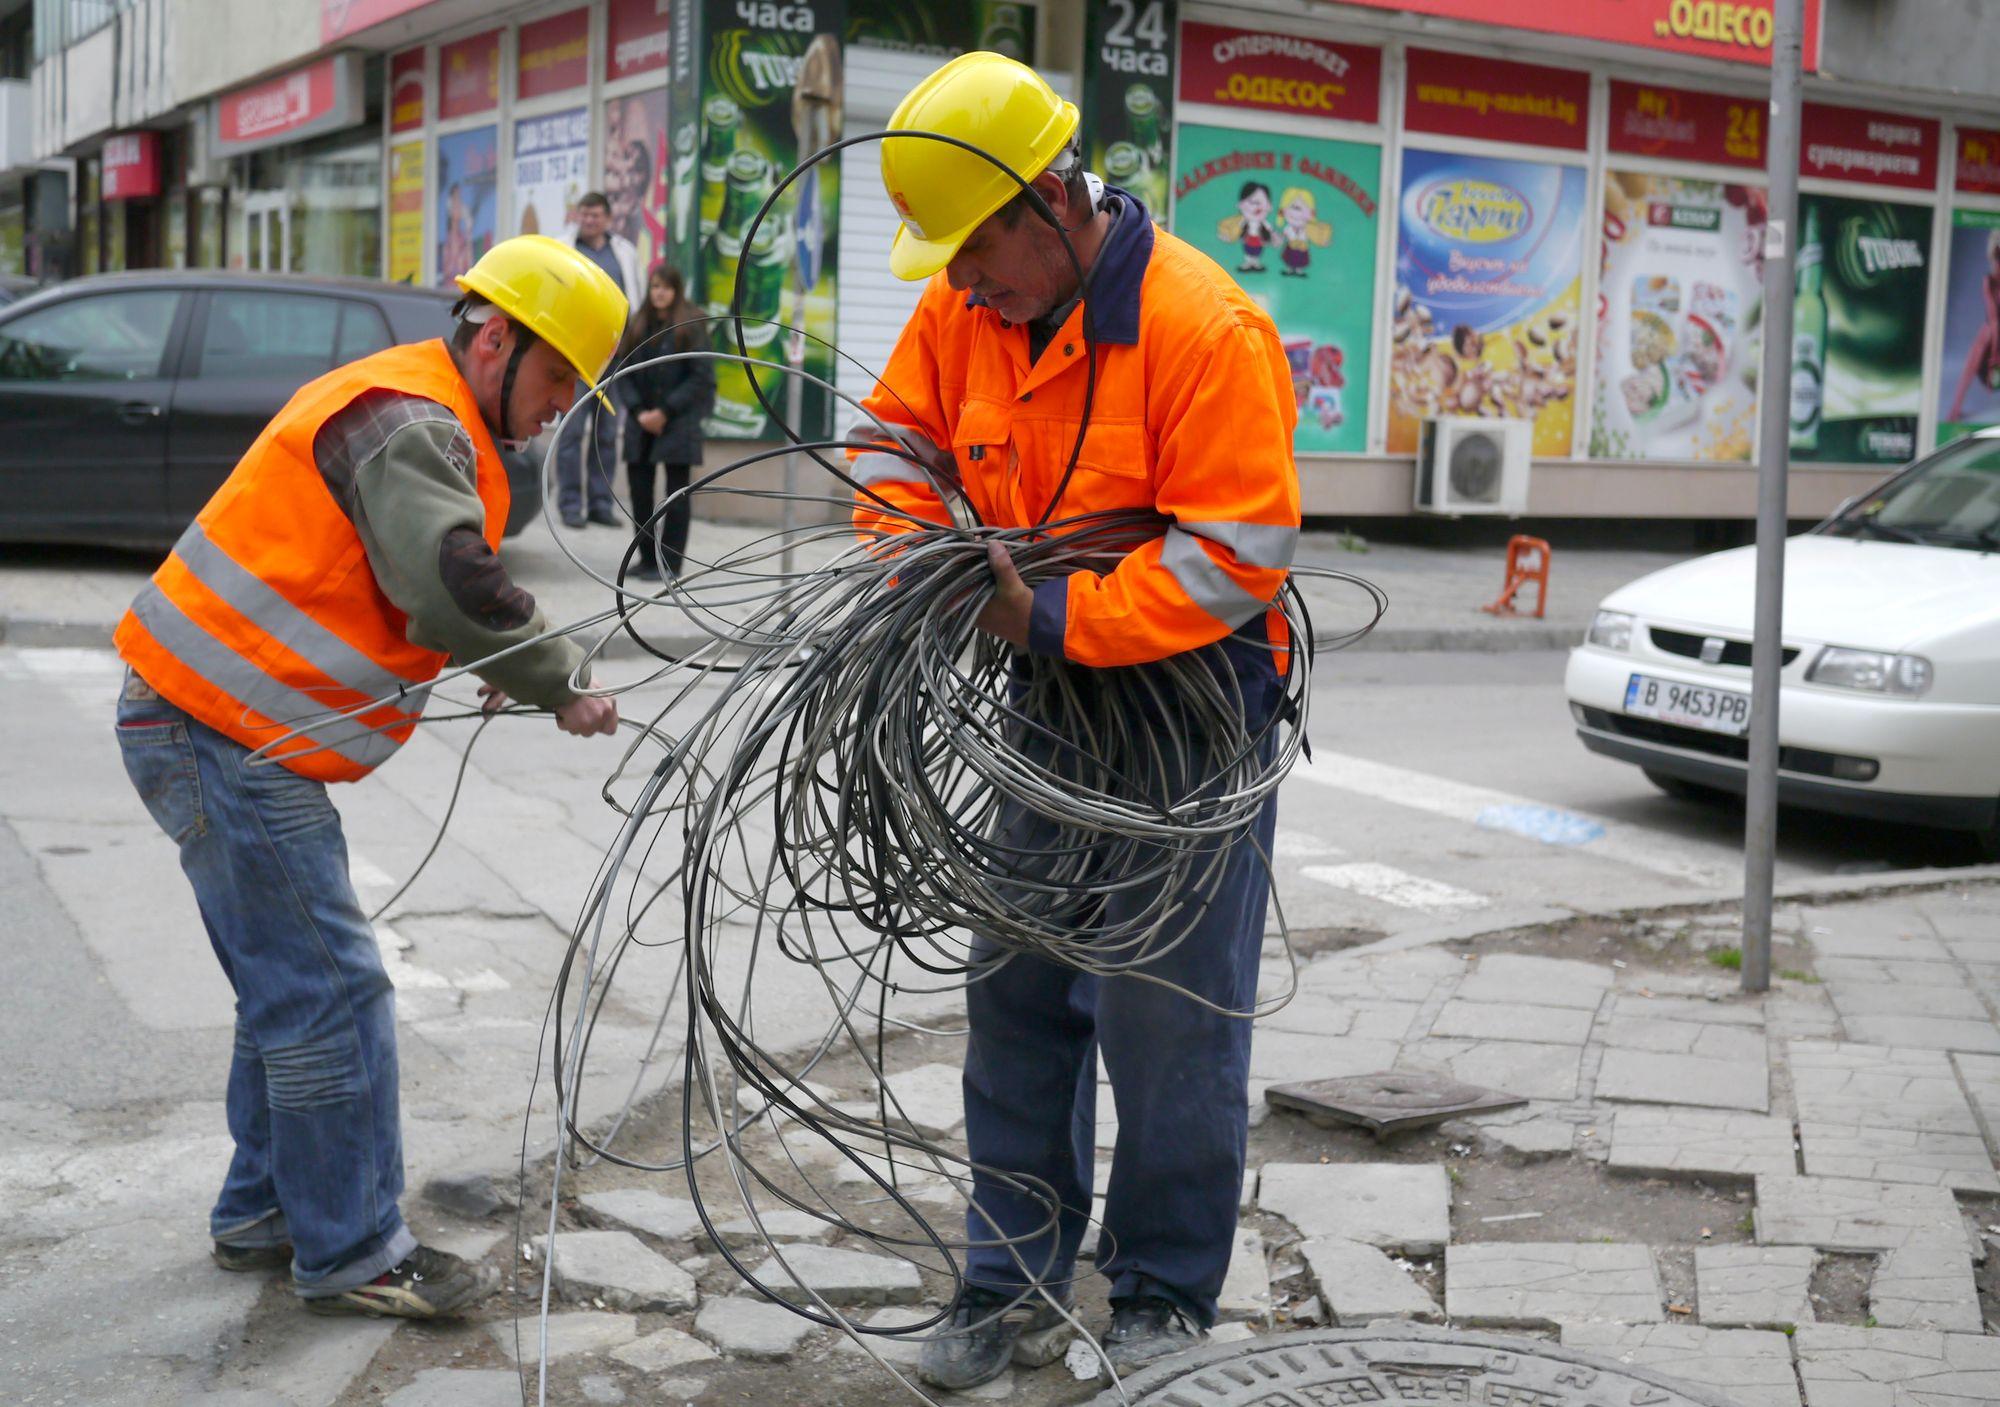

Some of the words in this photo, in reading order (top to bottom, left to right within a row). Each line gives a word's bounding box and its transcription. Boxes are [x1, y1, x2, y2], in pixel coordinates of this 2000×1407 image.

[736, 0, 816, 32] часа
[1104, 0, 1168, 50] 24
[1654, 0, 1774, 48] „ОДЕСО
[740, 51, 801, 89] TUB
[1101, 46, 1169, 77] часа
[1213, 34, 1350, 78] СУПЕРМАРКЕТ
[1727, 104, 1760, 140] 24
[1858, 235, 1925, 273] TUBORG
